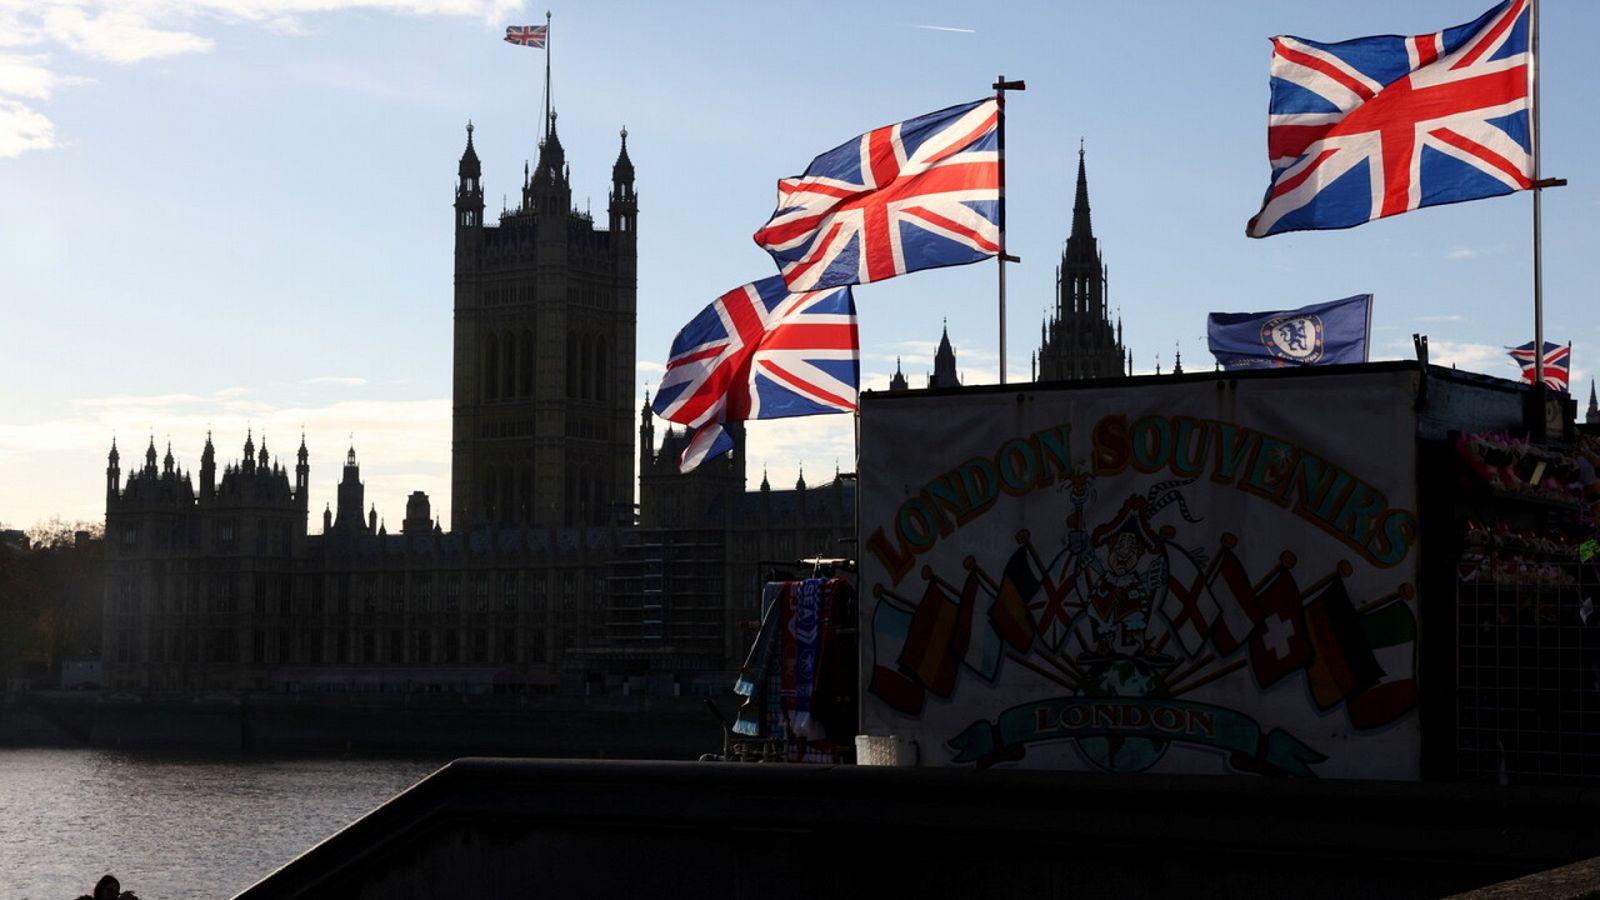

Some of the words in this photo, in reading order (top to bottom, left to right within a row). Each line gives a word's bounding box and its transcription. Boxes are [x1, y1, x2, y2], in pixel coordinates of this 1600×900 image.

[867, 423, 1072, 585] LONDON
[1092, 414, 1417, 568] SOUVENIRS
[1033, 703, 1217, 738] LONDON
